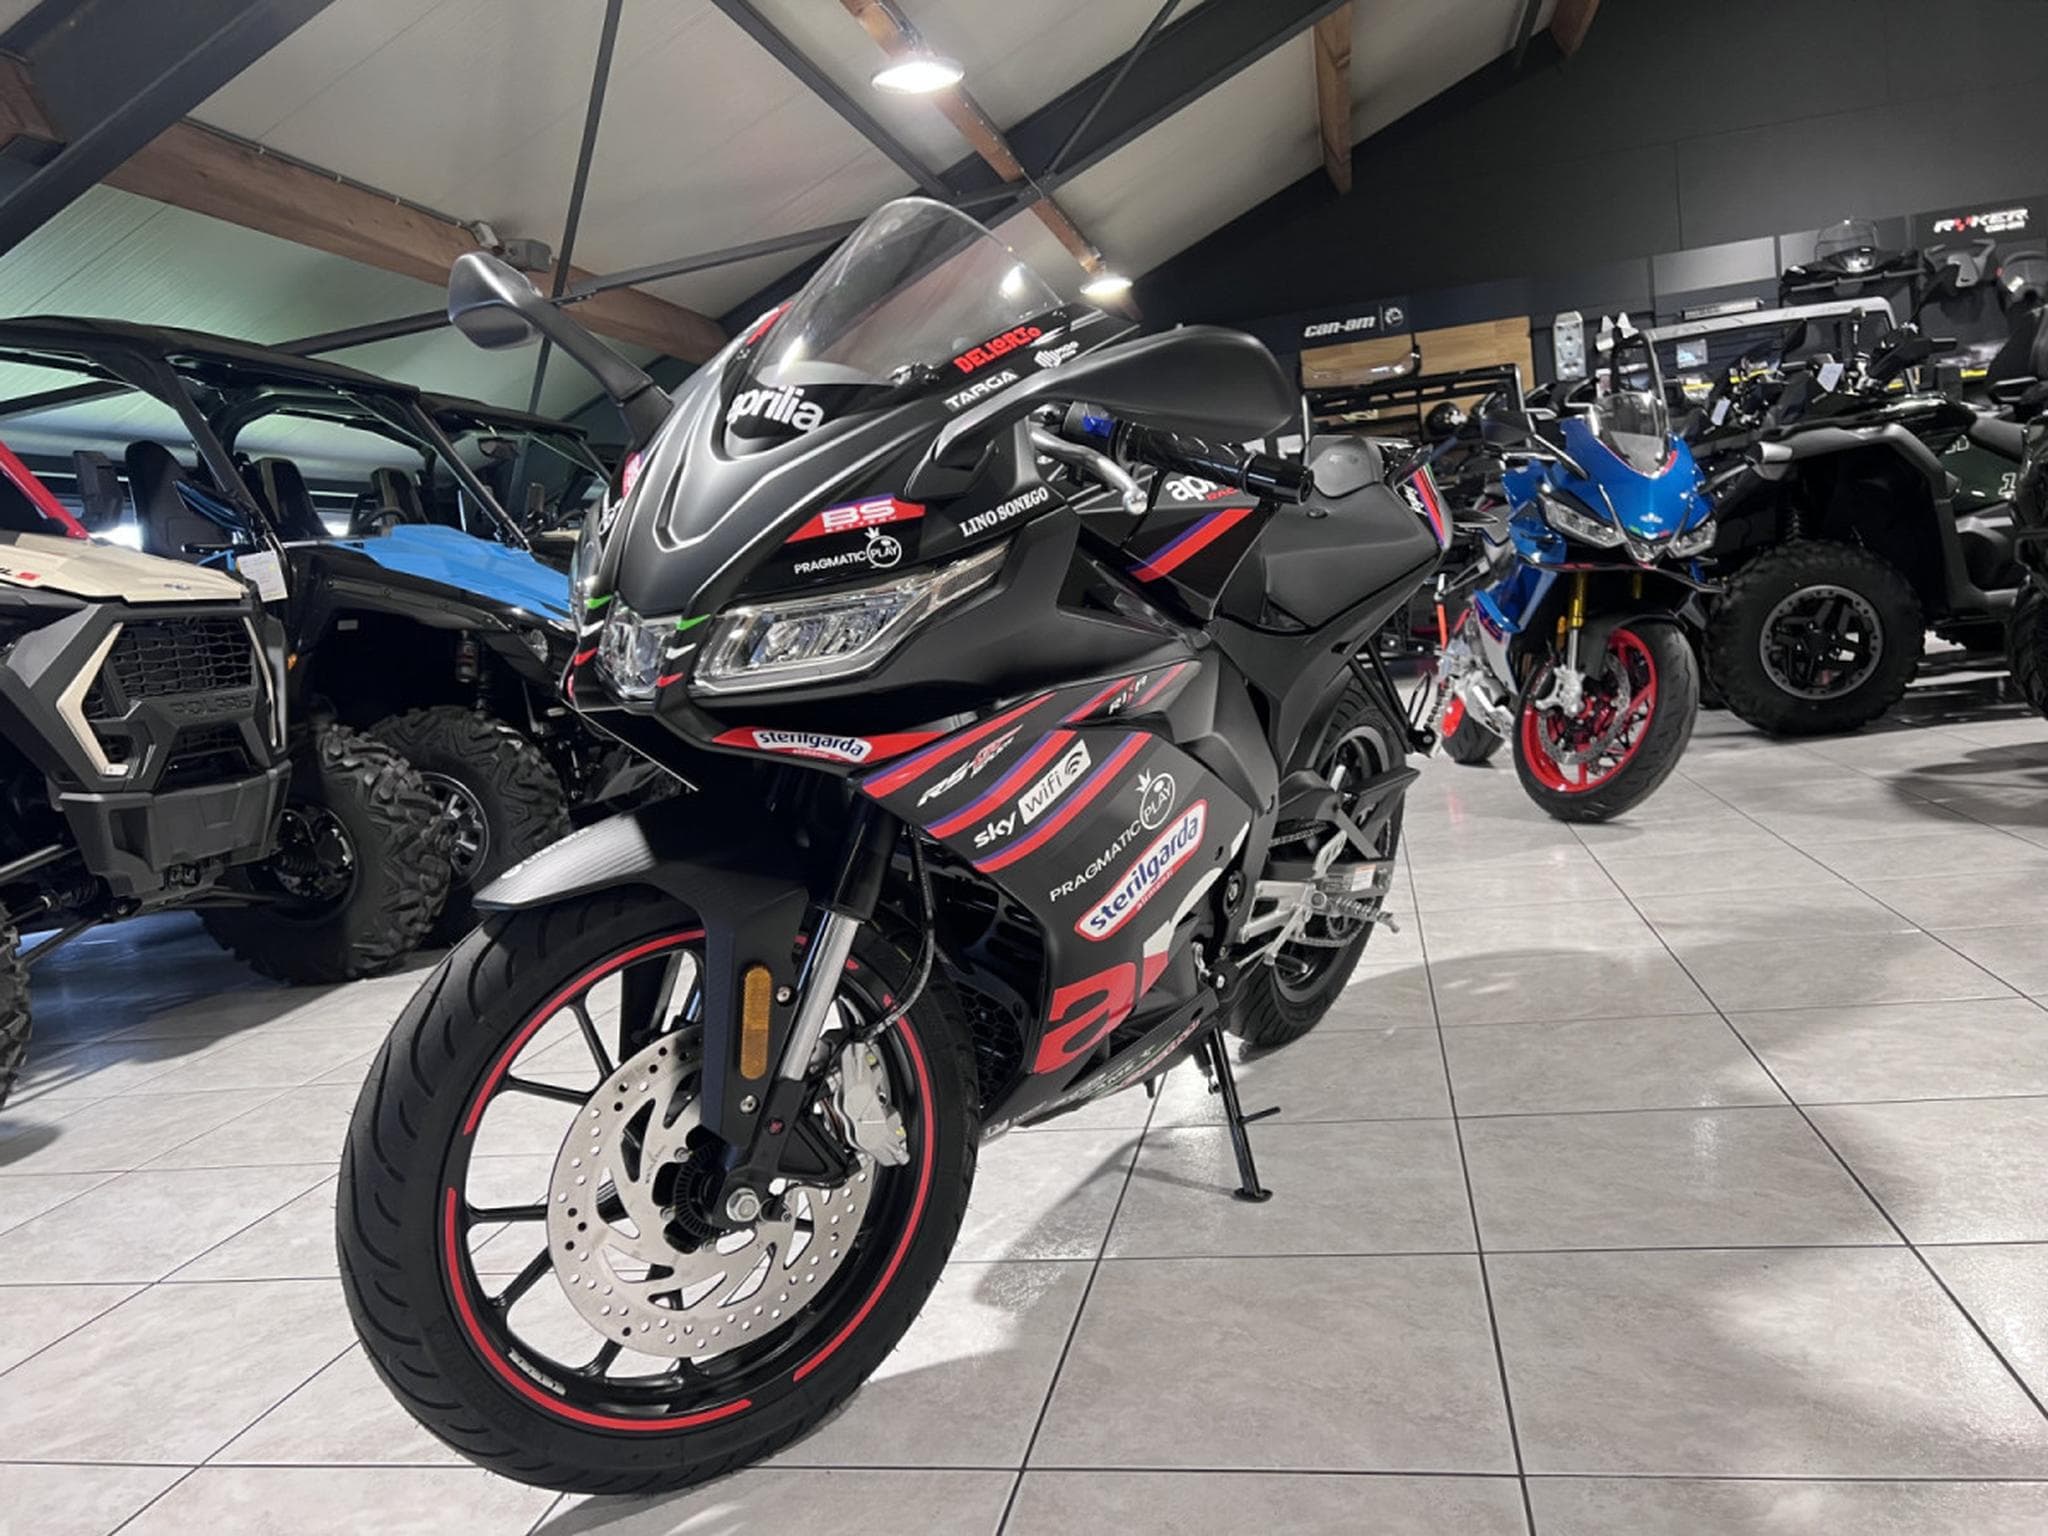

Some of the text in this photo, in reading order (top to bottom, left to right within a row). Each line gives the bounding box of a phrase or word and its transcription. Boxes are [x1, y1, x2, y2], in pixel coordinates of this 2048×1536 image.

[943, 370, 1019, 409] TARGA
[821, 499, 896, 528] BS
[959, 486, 1049, 538] LINO SONEGO
[793, 545, 898, 575] PRAGMATIC PLAY
[759, 731, 864, 756] sterilgarda
[973, 770, 1063, 849] sky wifi
[1050, 781, 1173, 902] PRAGMATIC PLAY
[1090, 816, 1199, 929] sterilgarda
